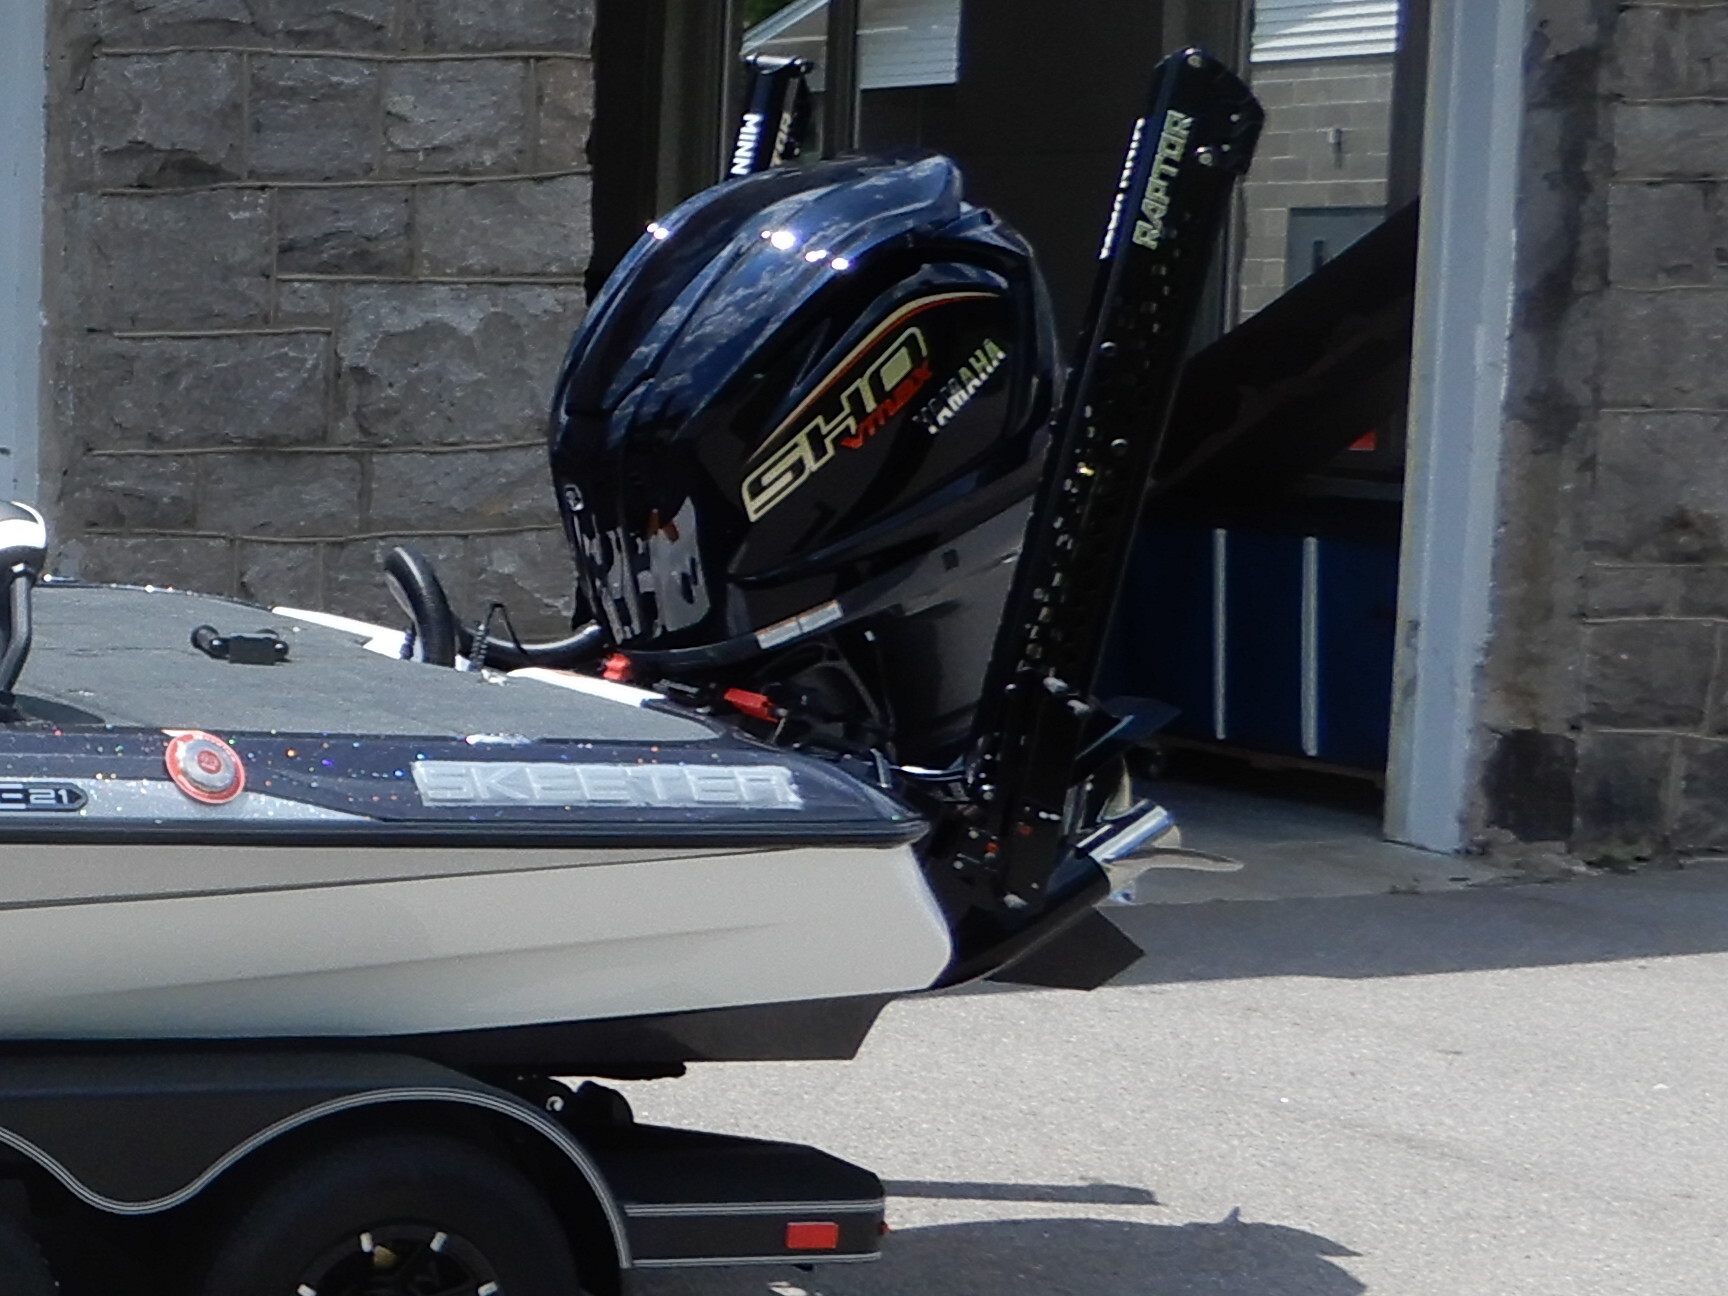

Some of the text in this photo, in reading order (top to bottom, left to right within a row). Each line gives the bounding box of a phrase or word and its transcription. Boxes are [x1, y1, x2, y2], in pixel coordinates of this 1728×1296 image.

[1132, 109, 1194, 251] RAPTOR
[741, 326, 928, 522] SHO
[911, 337, 1007, 435] YAMAHA
[416, 764, 800, 807] SKEETER
